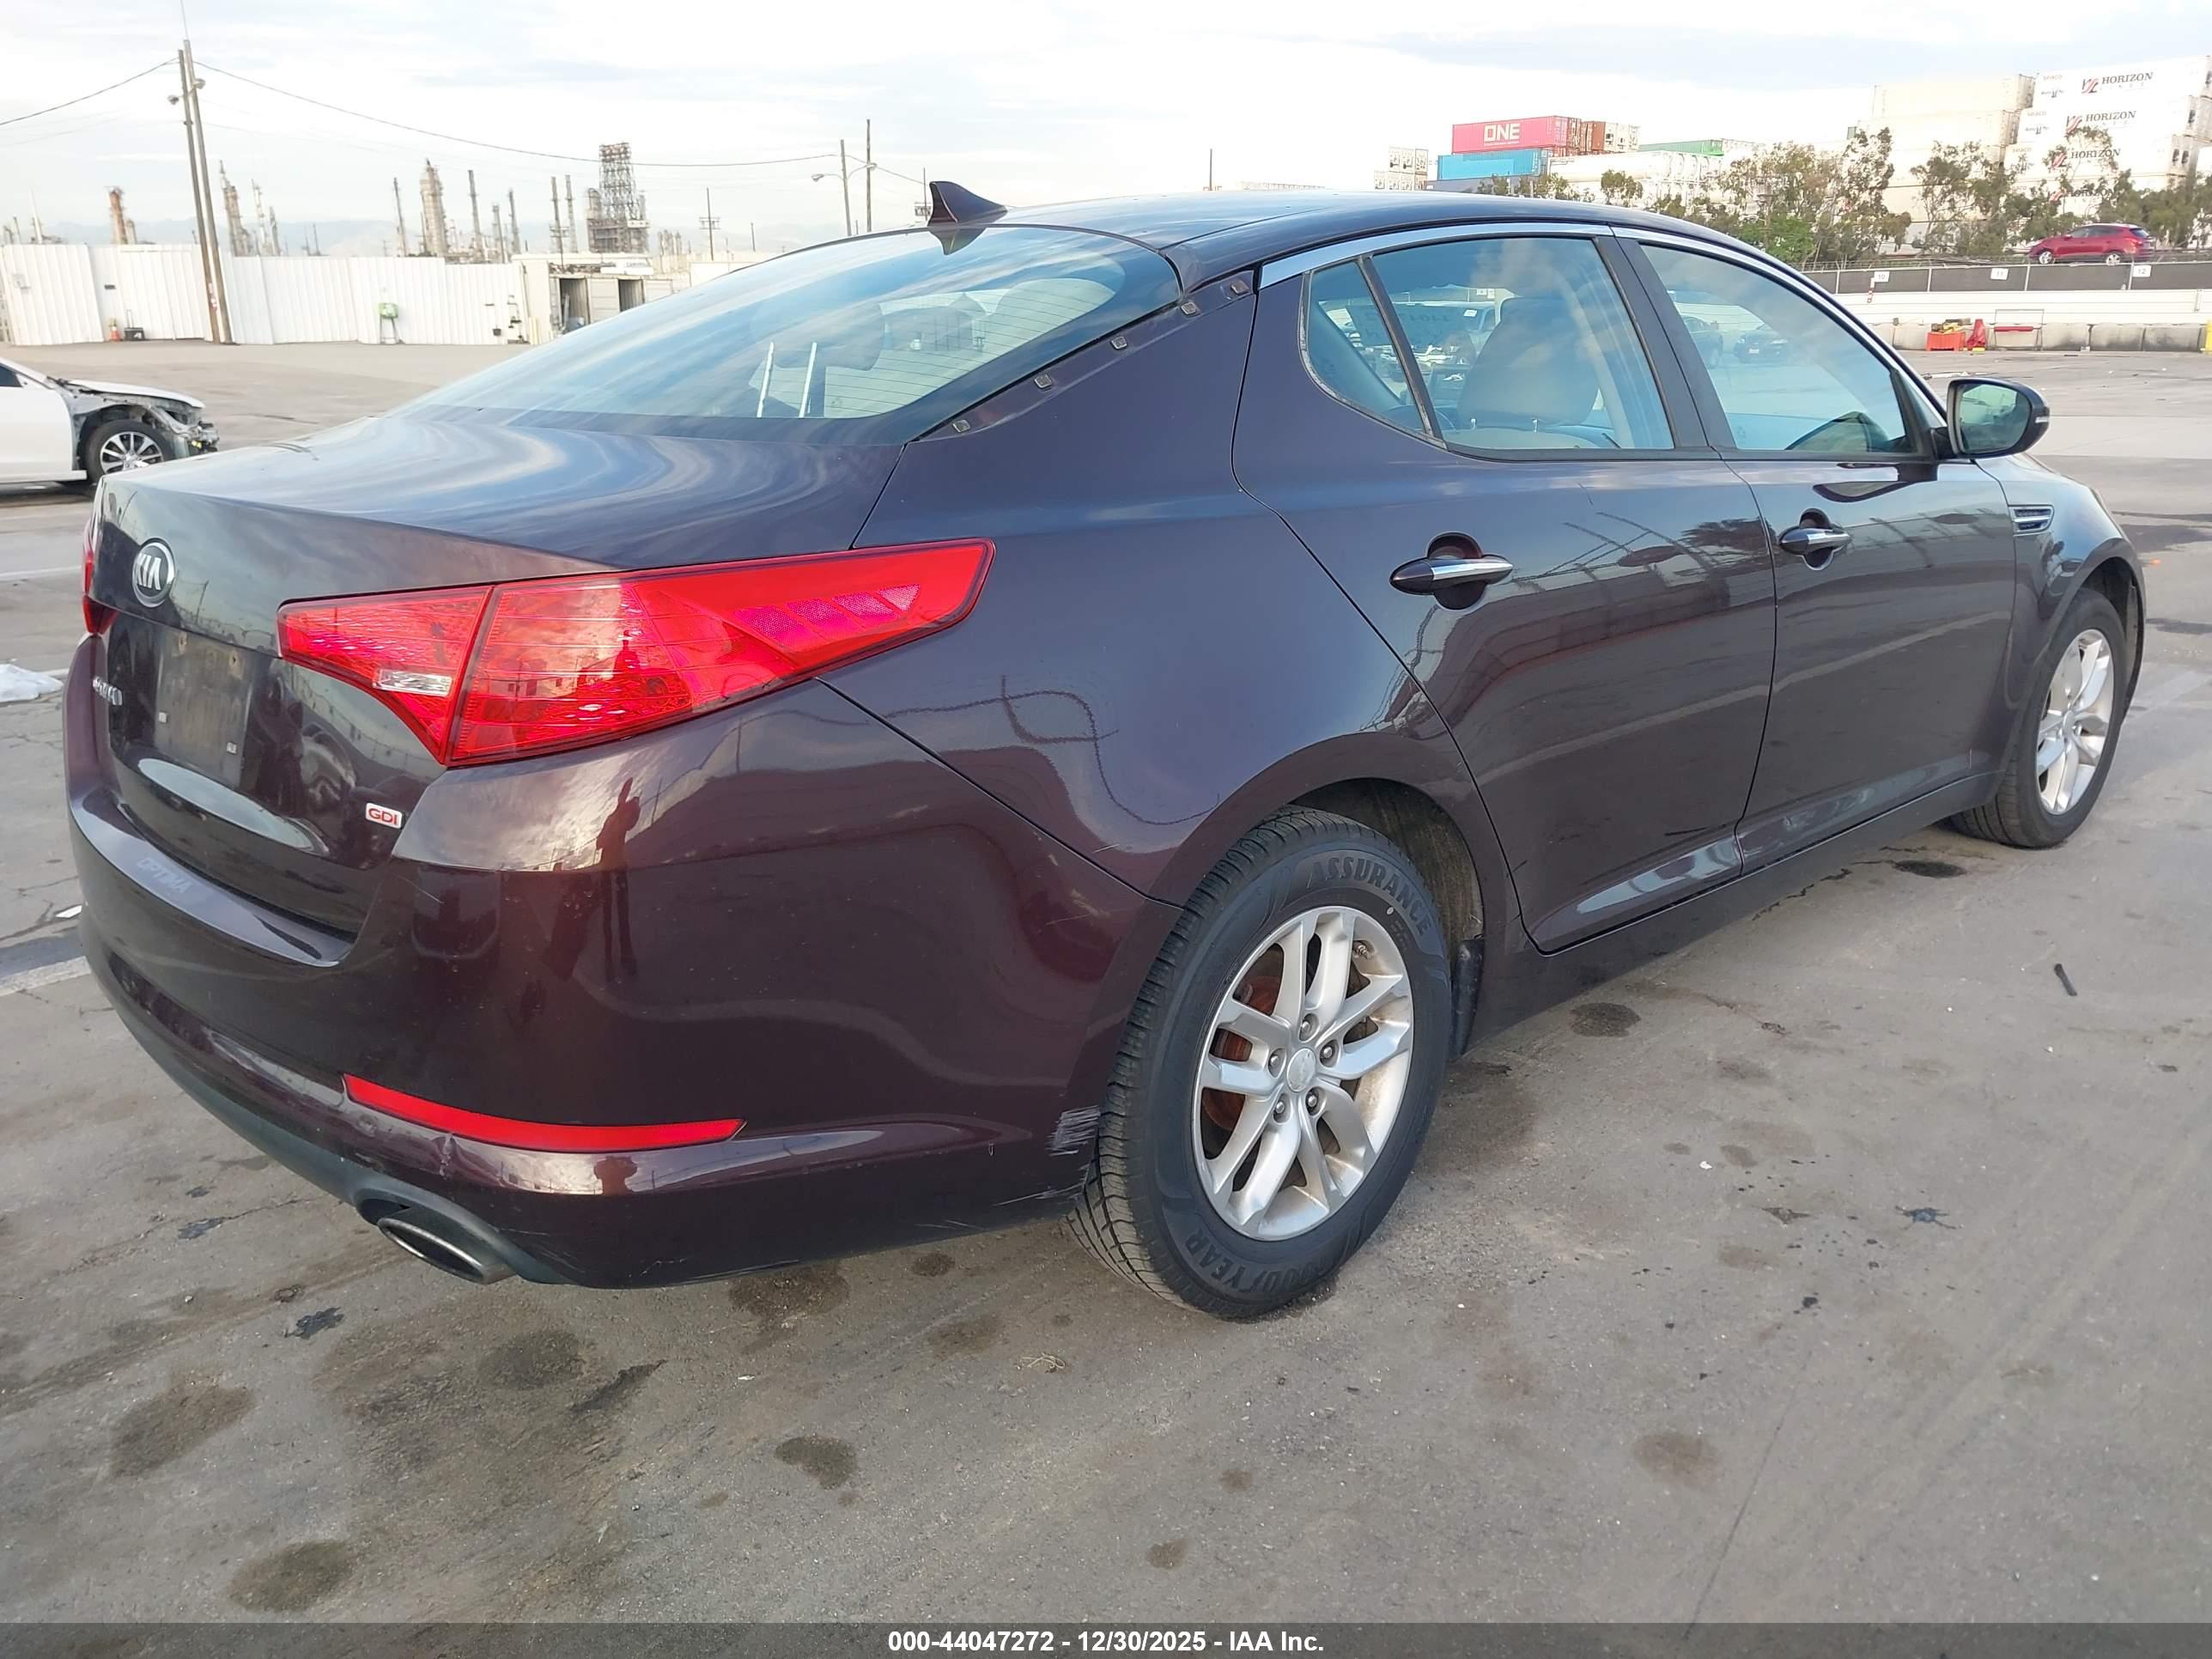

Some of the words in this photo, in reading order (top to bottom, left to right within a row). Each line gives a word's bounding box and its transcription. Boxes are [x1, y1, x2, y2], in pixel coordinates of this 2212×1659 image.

[2101, 71, 2154, 84] HORIZON
[2085, 110, 2136, 122] HORIZON
[1484, 123, 1521, 142] ONE
[2071, 148, 2121, 159] HORIZON
[137, 552, 161, 591] KIA
[368, 808, 398, 825] GDI
[1307, 856, 1432, 936] ASSURANCE
